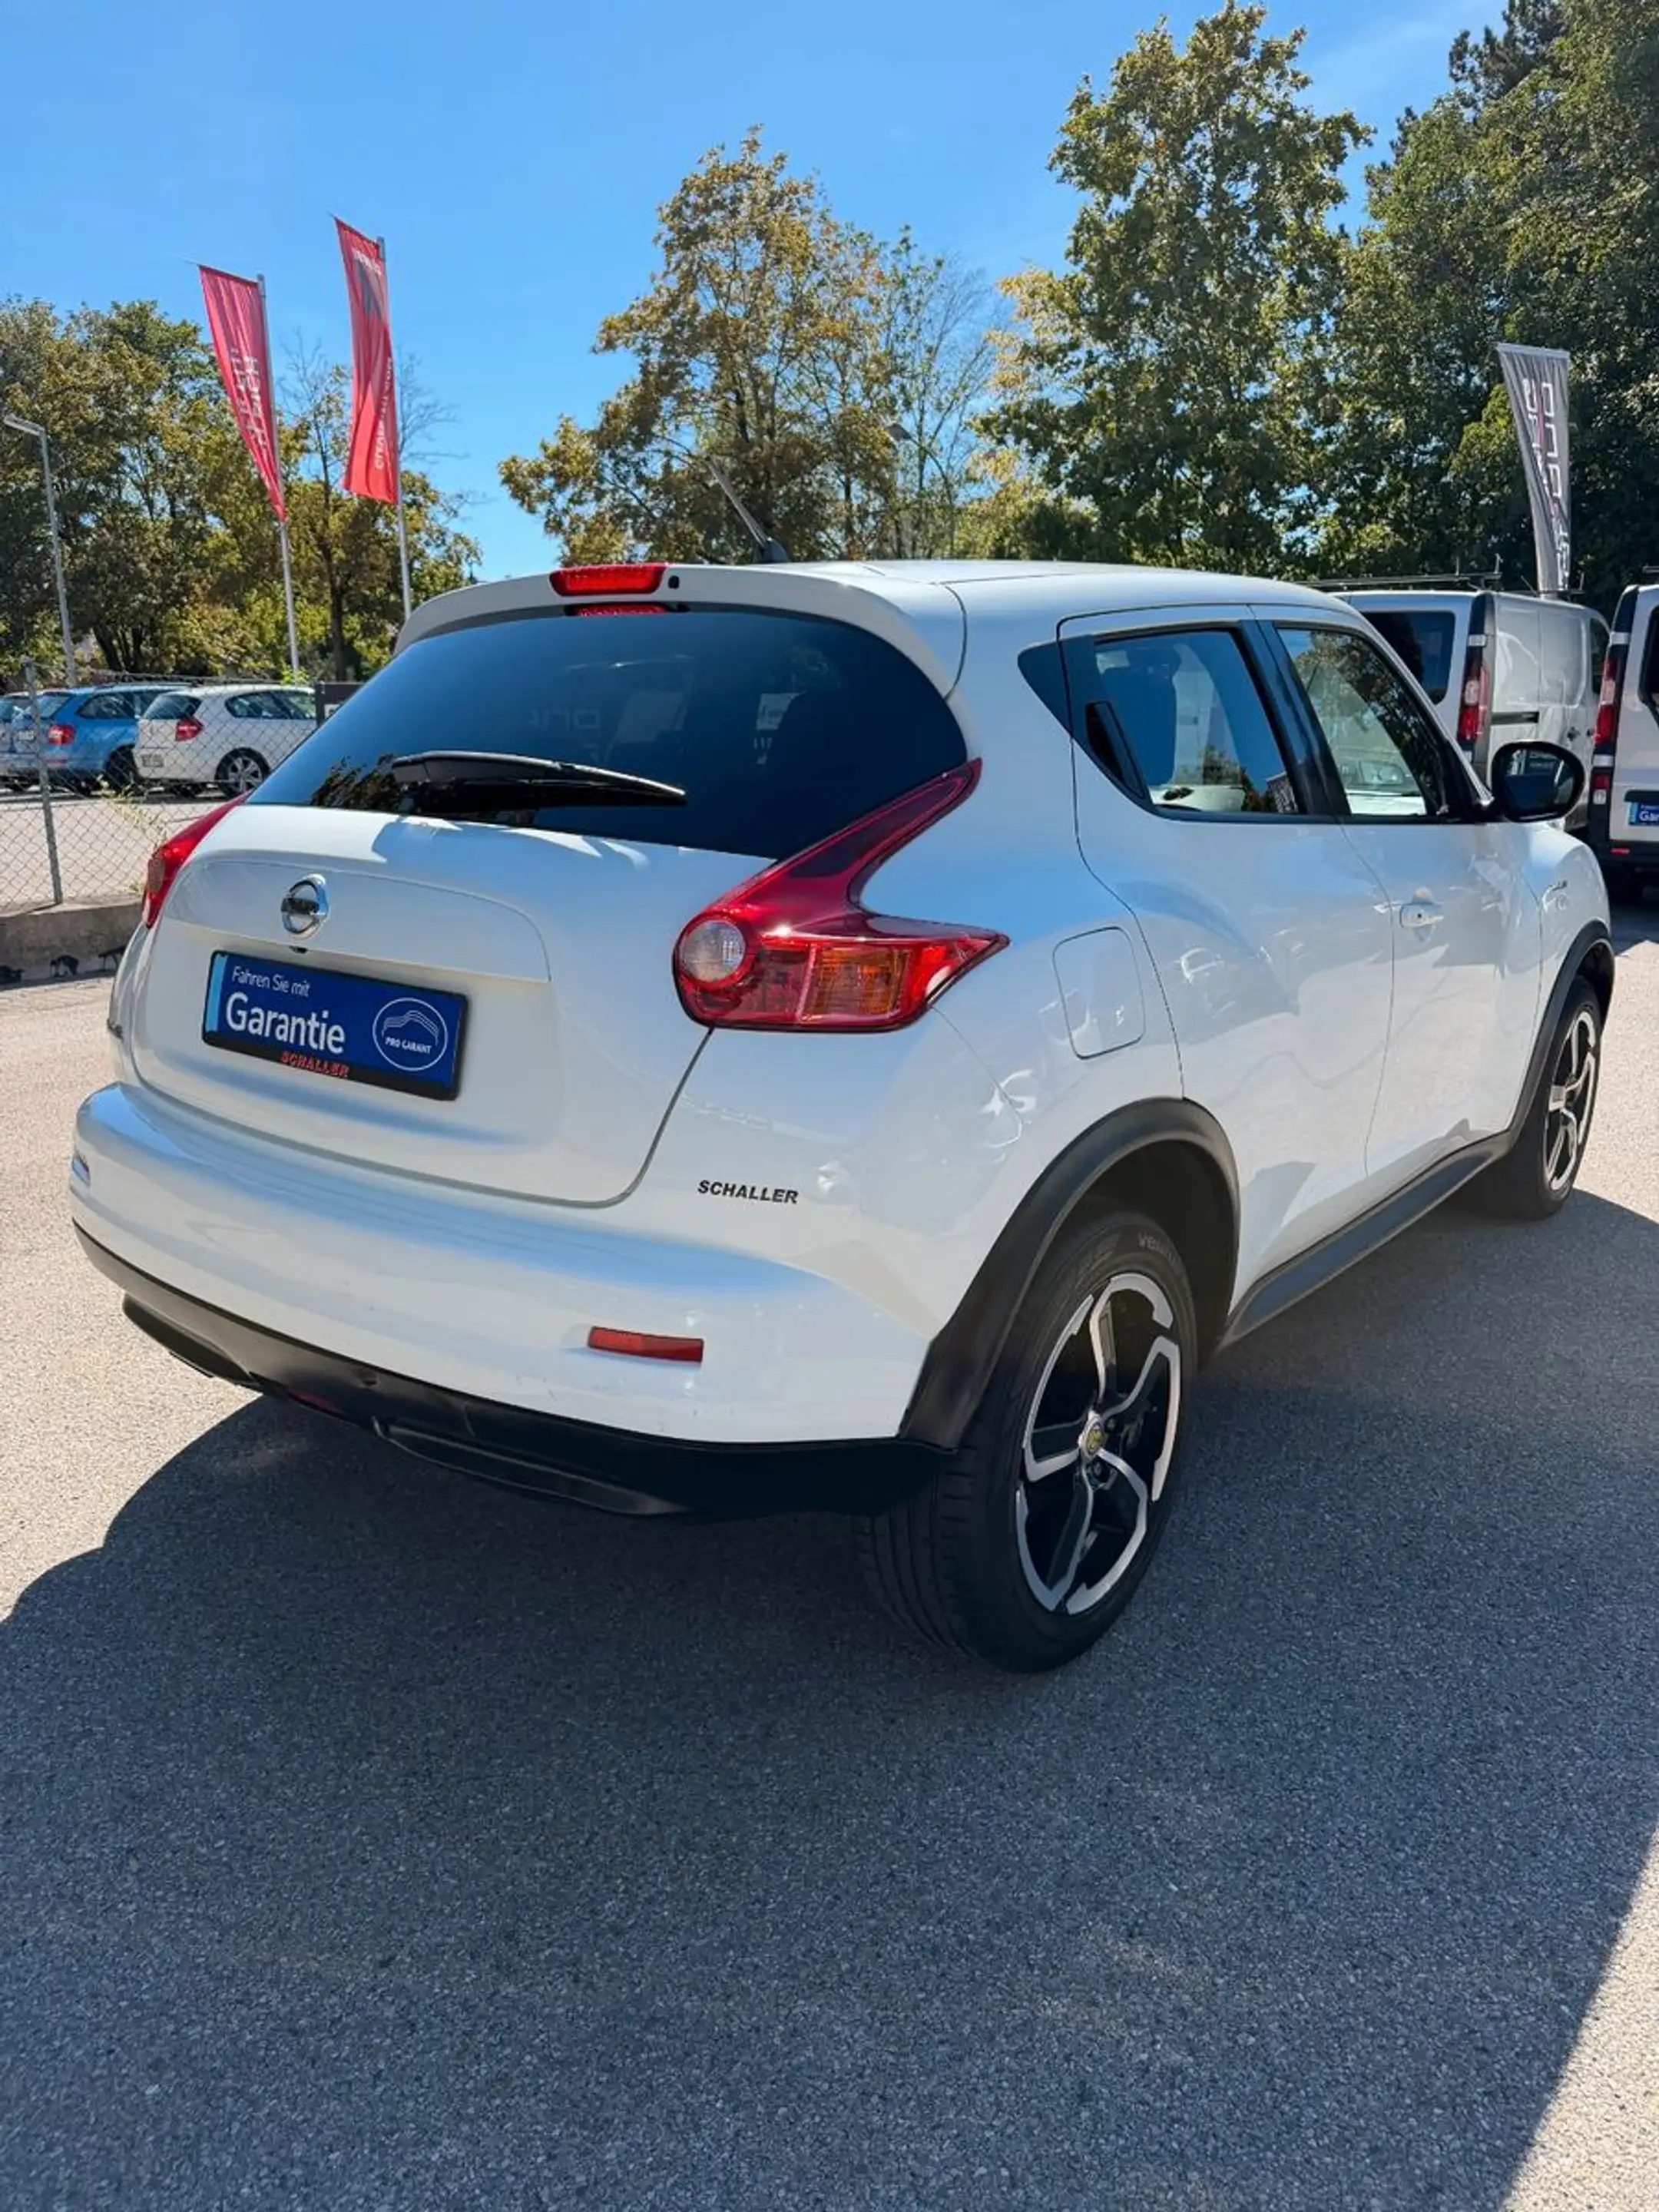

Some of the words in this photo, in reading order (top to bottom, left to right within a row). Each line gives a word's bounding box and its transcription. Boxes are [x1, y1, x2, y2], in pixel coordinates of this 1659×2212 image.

[232, 965, 270, 988] Fahren
[272, 974, 290, 992] Sie
[291, 981, 310, 997] mit
[226, 992, 346, 1055] Garantie
[280, 1051, 349, 1078] SCHALLER
[697, 1180, 799, 1204] SCHALLER
